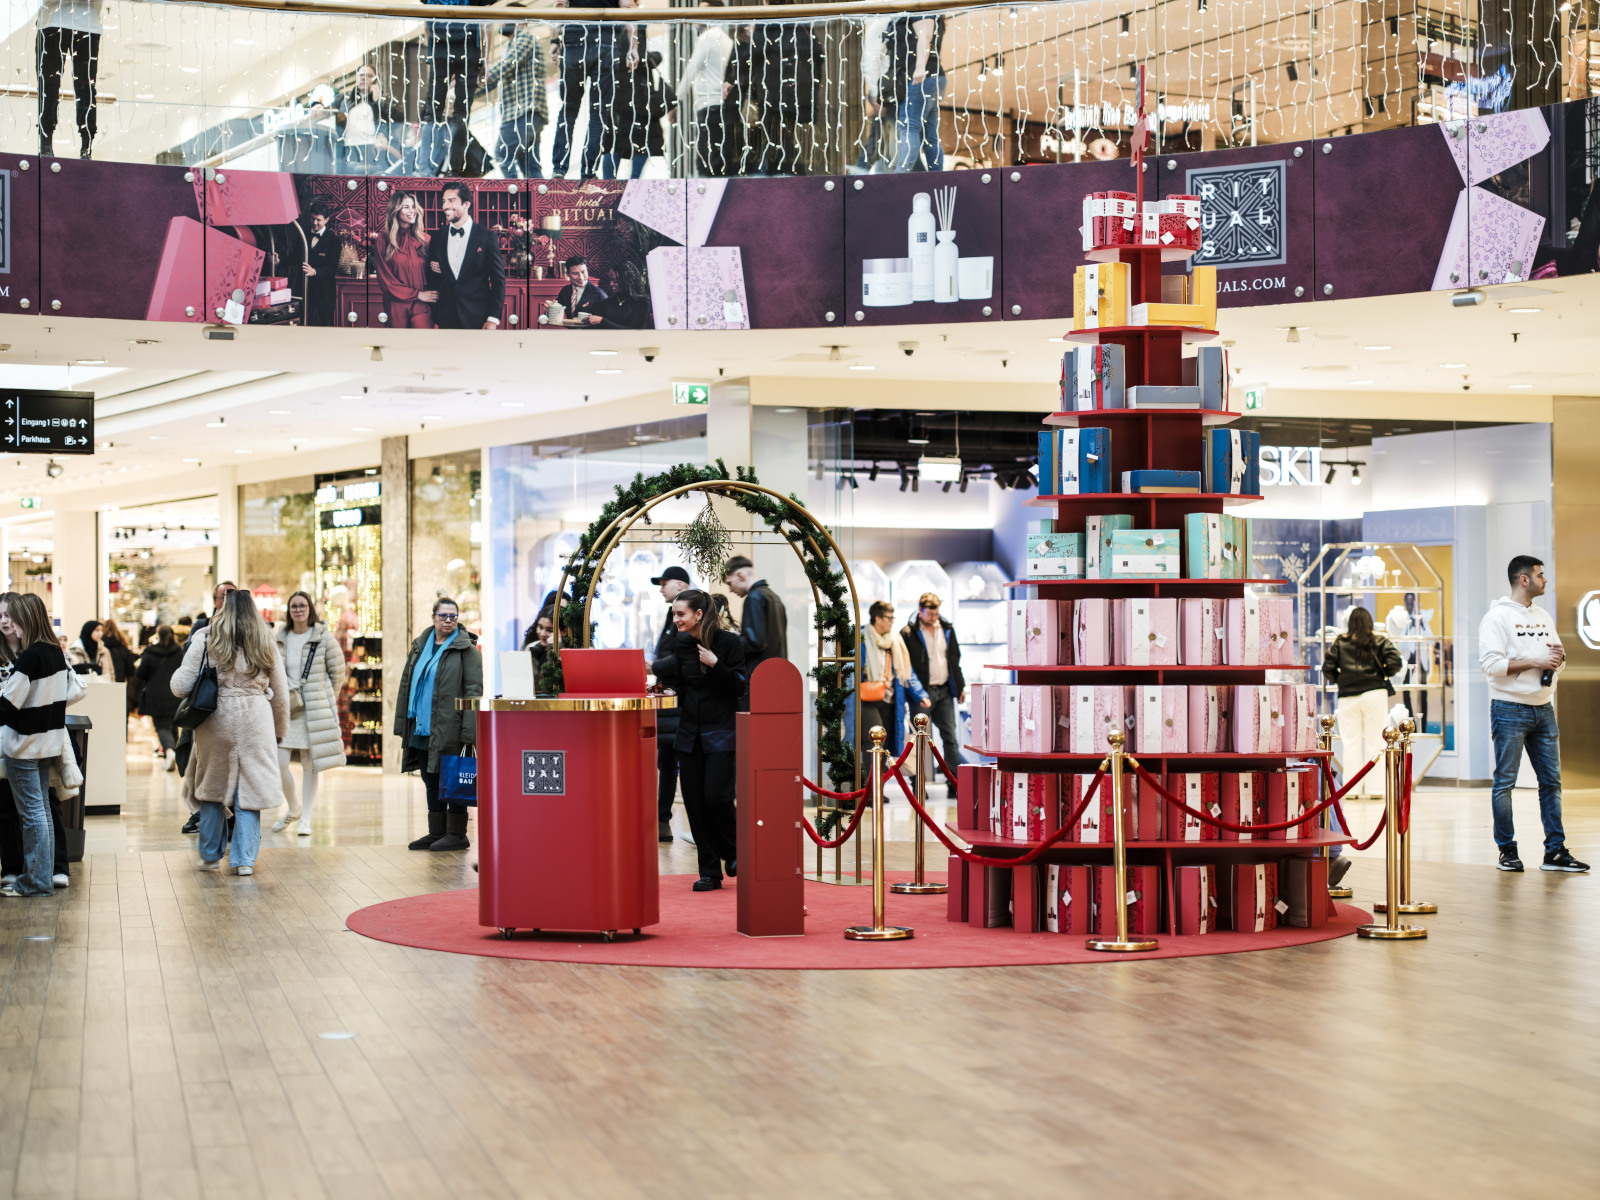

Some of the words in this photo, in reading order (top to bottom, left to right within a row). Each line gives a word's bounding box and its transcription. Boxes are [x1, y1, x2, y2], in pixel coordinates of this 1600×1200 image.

[576, 195, 603, 207] hotel
[21, 418, 47, 428] Eingang
[21, 435, 51, 444] Parkhaus
[1259, 445, 1323, 486] SKI
